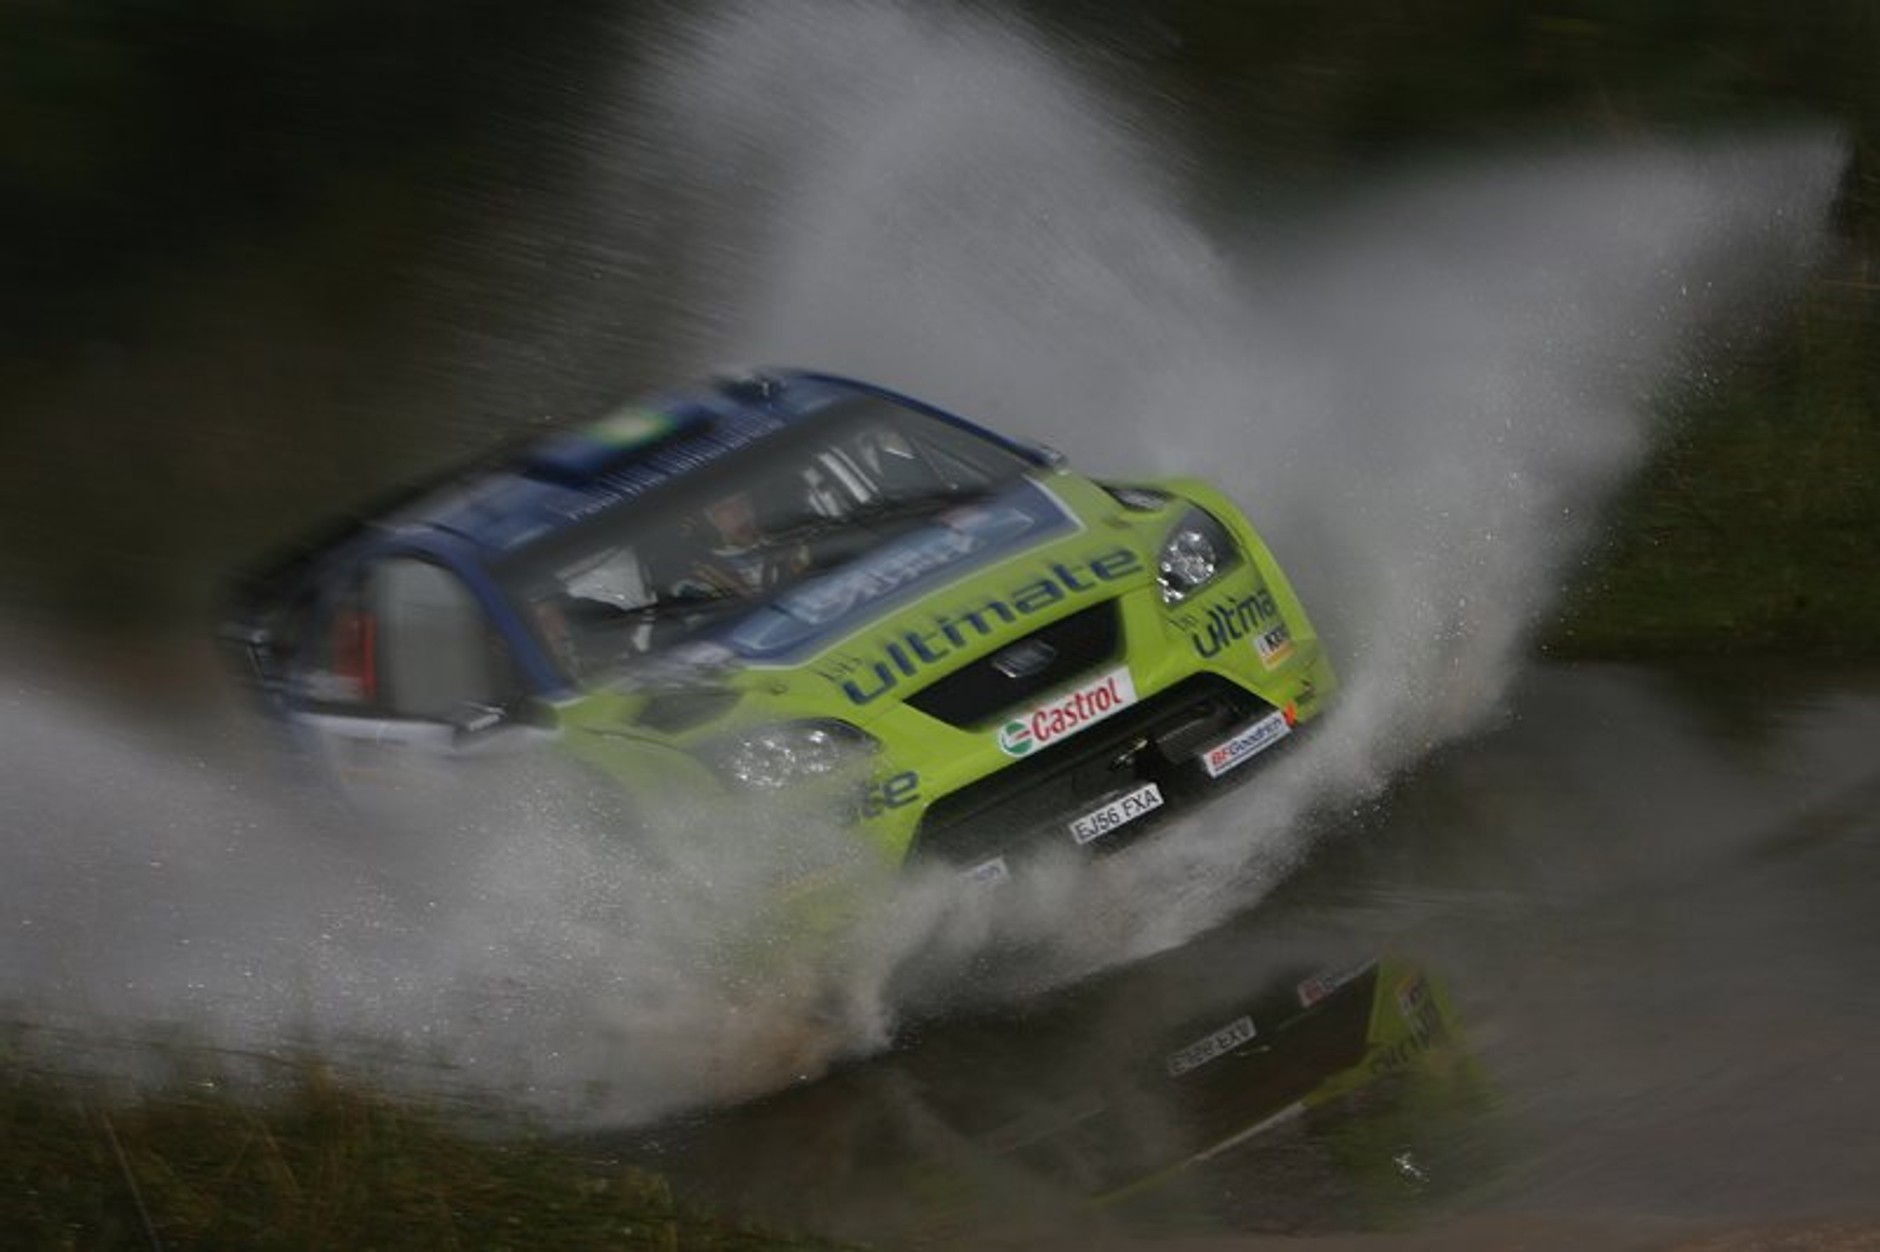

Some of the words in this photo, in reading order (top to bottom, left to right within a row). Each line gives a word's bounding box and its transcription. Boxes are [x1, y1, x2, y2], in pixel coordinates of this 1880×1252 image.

[1031, 677, 1123, 742] Castrol
[1074, 807, 1120, 841] EJ56
[1121, 789, 1160, 817] FXA
